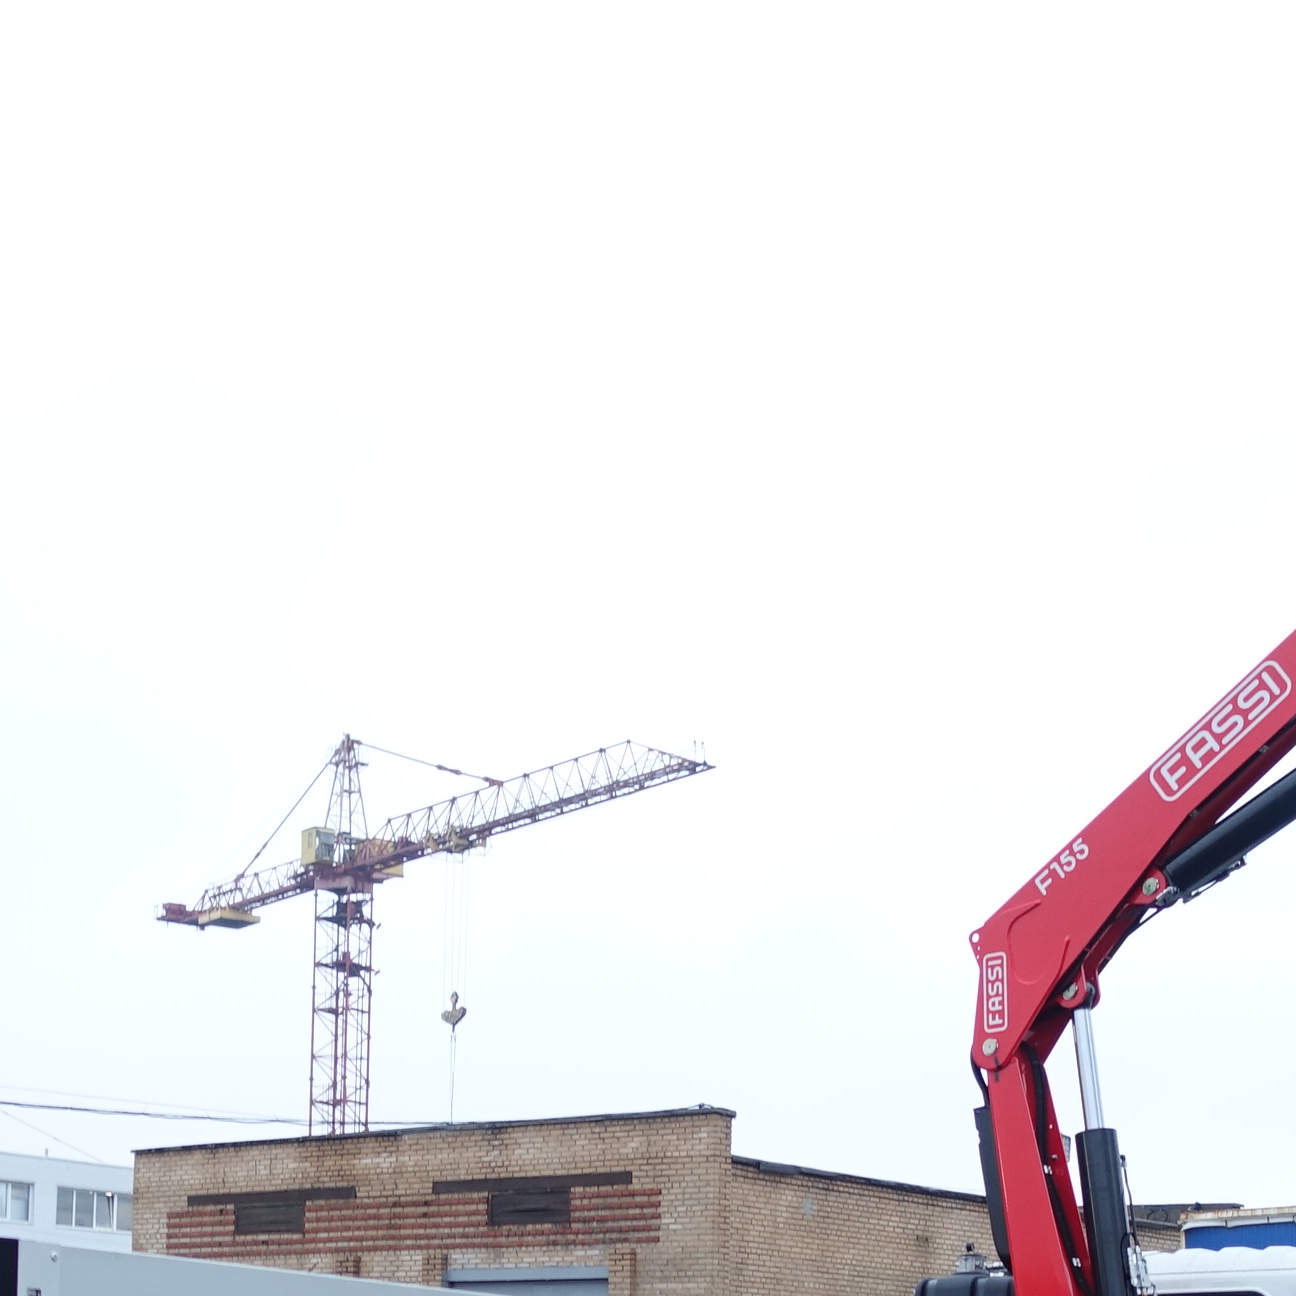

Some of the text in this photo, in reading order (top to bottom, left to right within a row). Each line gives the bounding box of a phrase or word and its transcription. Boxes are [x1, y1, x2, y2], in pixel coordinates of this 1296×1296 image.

[1159, 670, 1282, 791] FASSI
[1034, 837, 1090, 896] F155
[987, 959, 1004, 1027] FASSI
